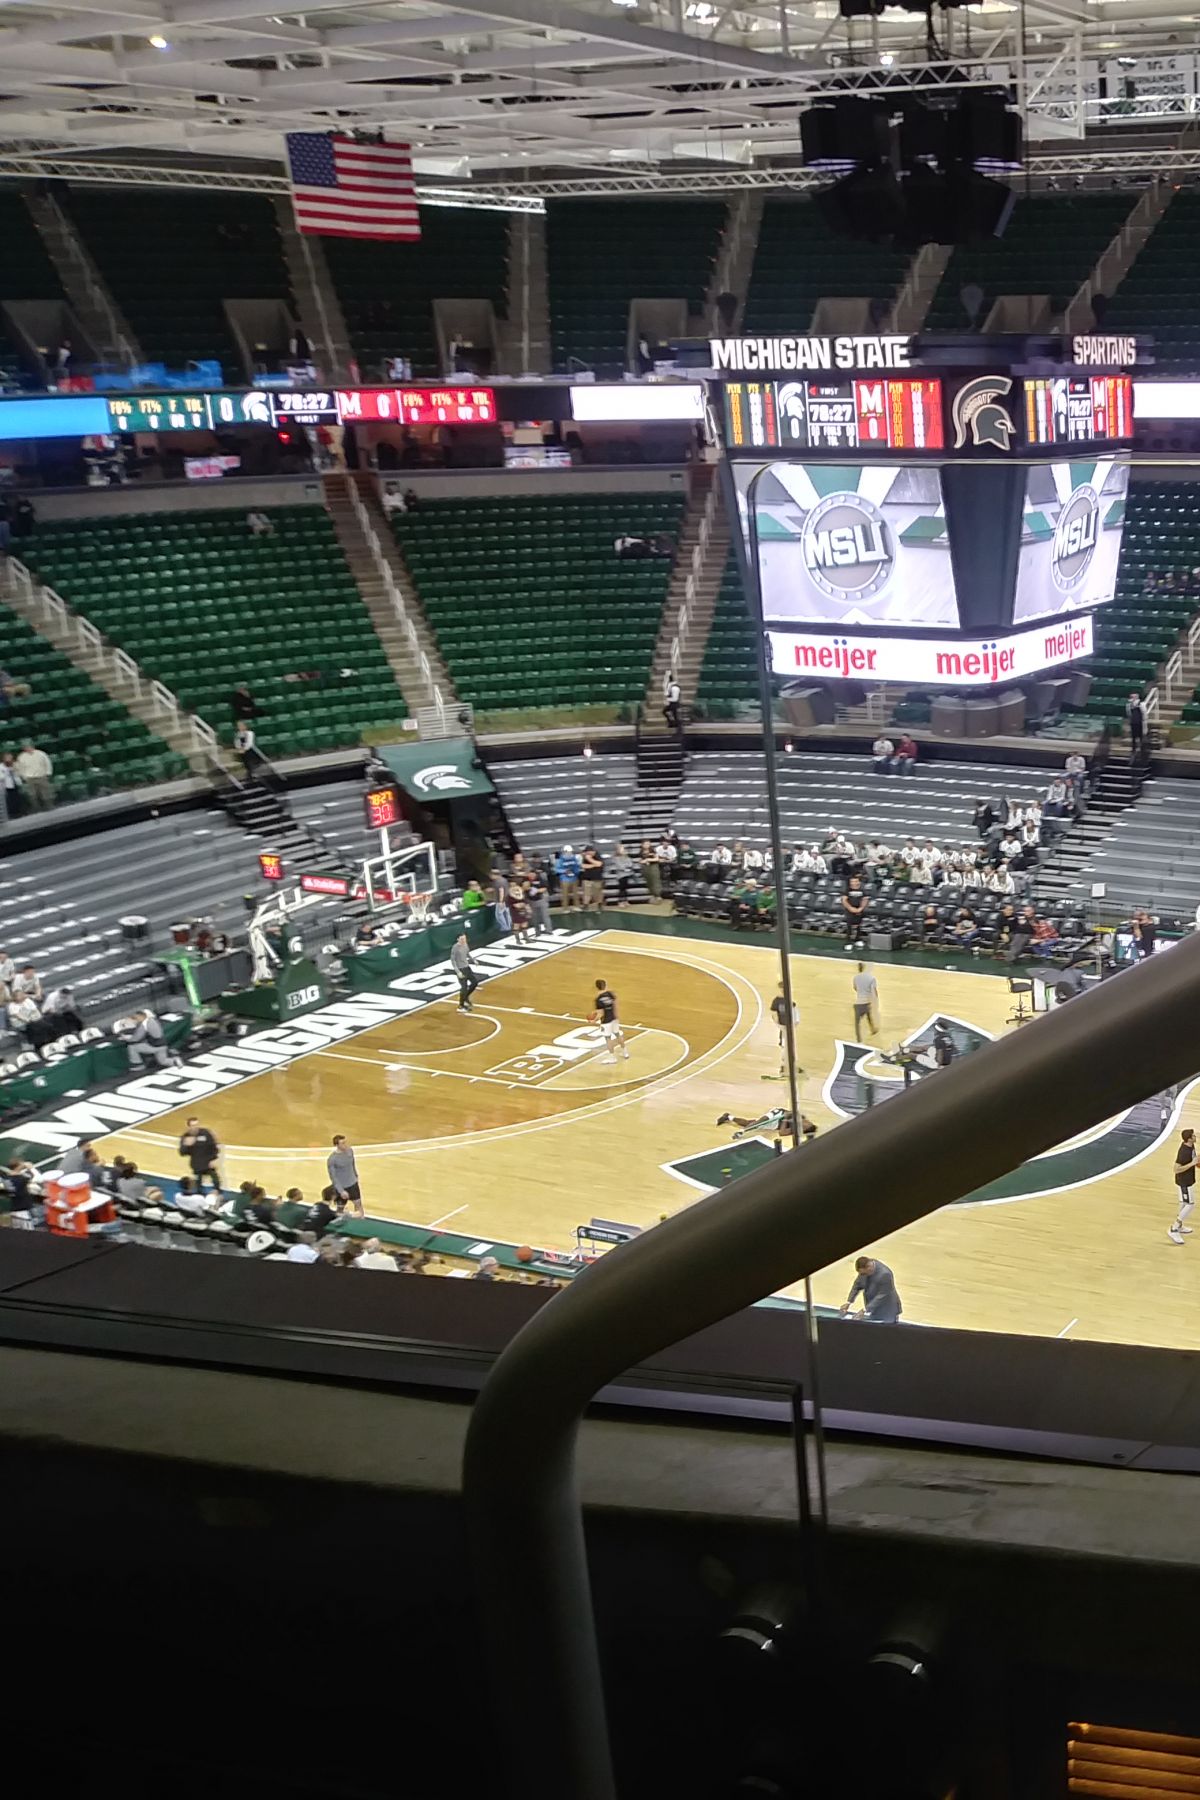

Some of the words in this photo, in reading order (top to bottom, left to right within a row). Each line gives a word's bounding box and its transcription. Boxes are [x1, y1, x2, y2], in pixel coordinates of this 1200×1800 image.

[1117, 83, 1186, 97] CAMPIONS
[709, 338, 831, 371] MICHIGAN
[834, 335, 912, 369] STATE
[1073, 335, 1137, 365] SPARTANS
[220, 397, 234, 422] 0
[278, 392, 329, 411] 78:27
[338, 392, 362, 417] M
[377, 393, 391, 418] 0
[810, 404, 853, 422] 78:27
[859, 384, 883, 415] M
[790, 418, 800, 439] 0
[868, 418, 878, 439] 0
[804, 521, 889, 569] MSU
[1053, 508, 1098, 563] MSU
[1044, 623, 1087, 660] meijer
[794, 638, 877, 679] meijer
[935, 642, 1016, 681] meijer
[0, 991, 428, 1153] MICHIGAN
